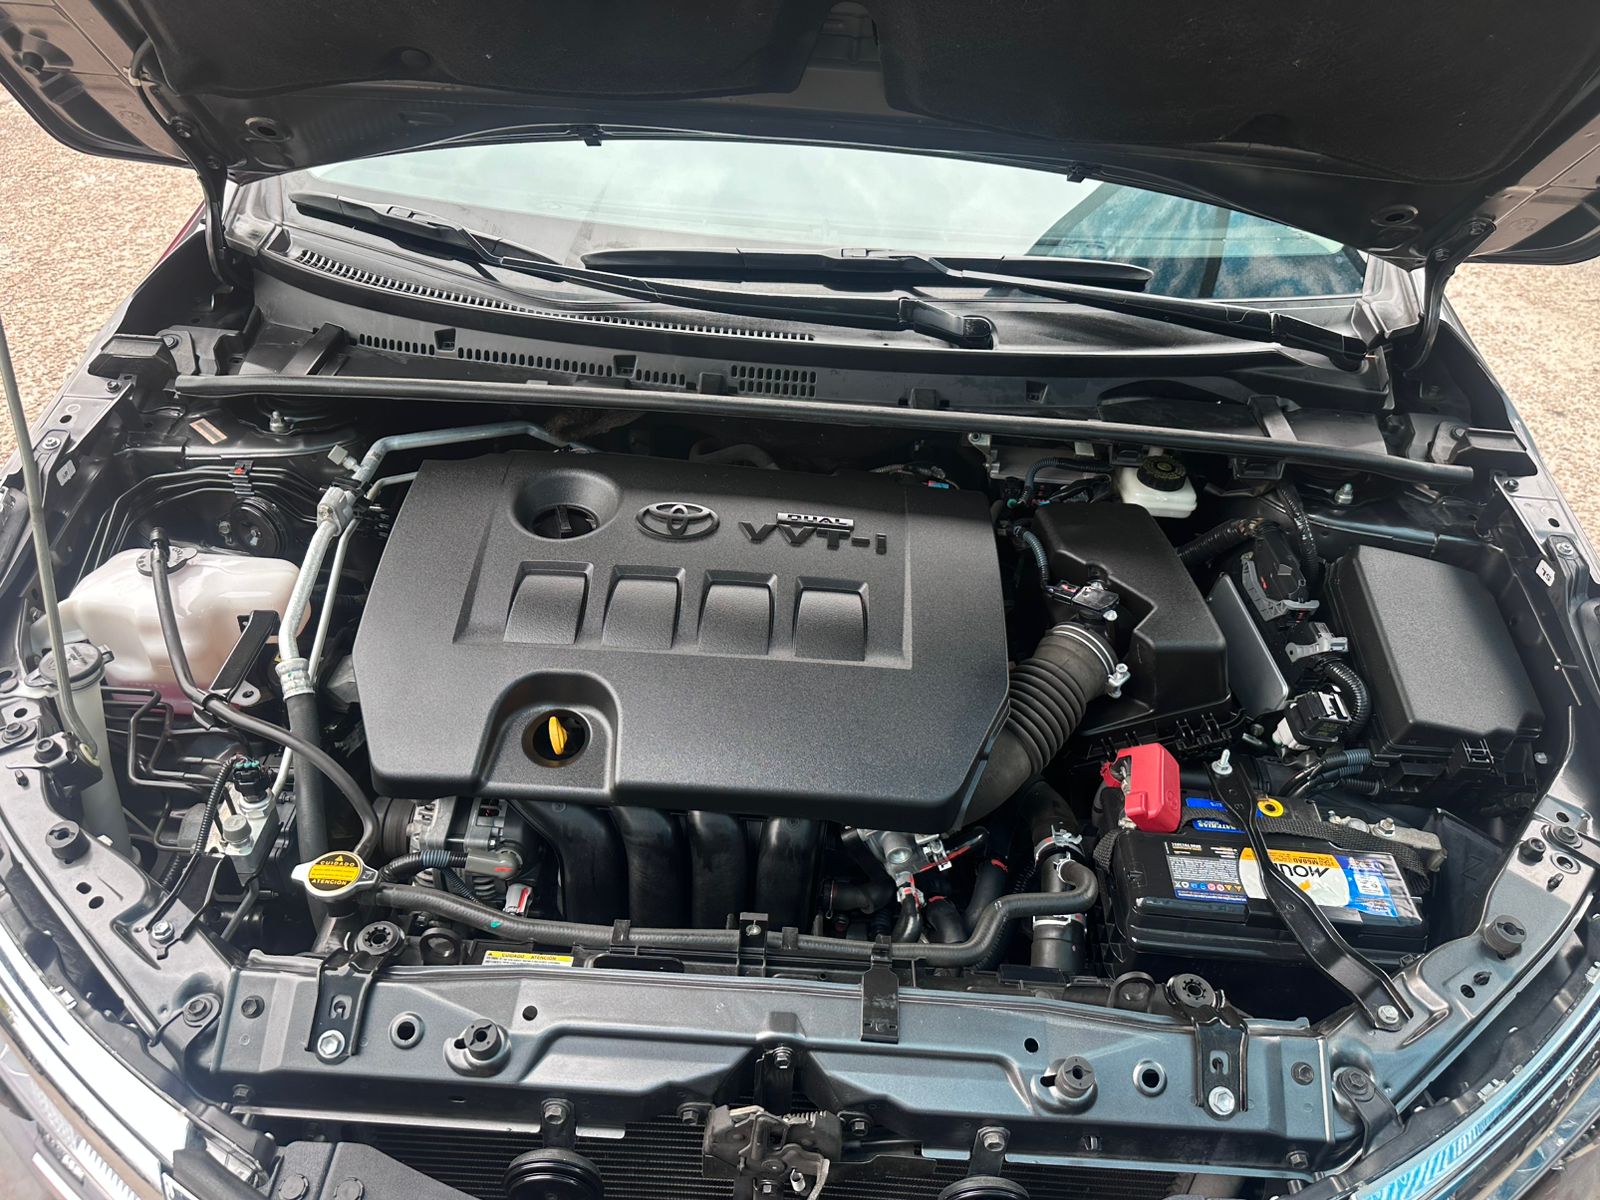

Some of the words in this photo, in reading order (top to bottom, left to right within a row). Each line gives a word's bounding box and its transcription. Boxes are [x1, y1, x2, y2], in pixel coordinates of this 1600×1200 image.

[787, 514, 848, 525] DUAL
[738, 520, 887, 555] VVT-i
[1273, 862, 1330, 878] MOU
